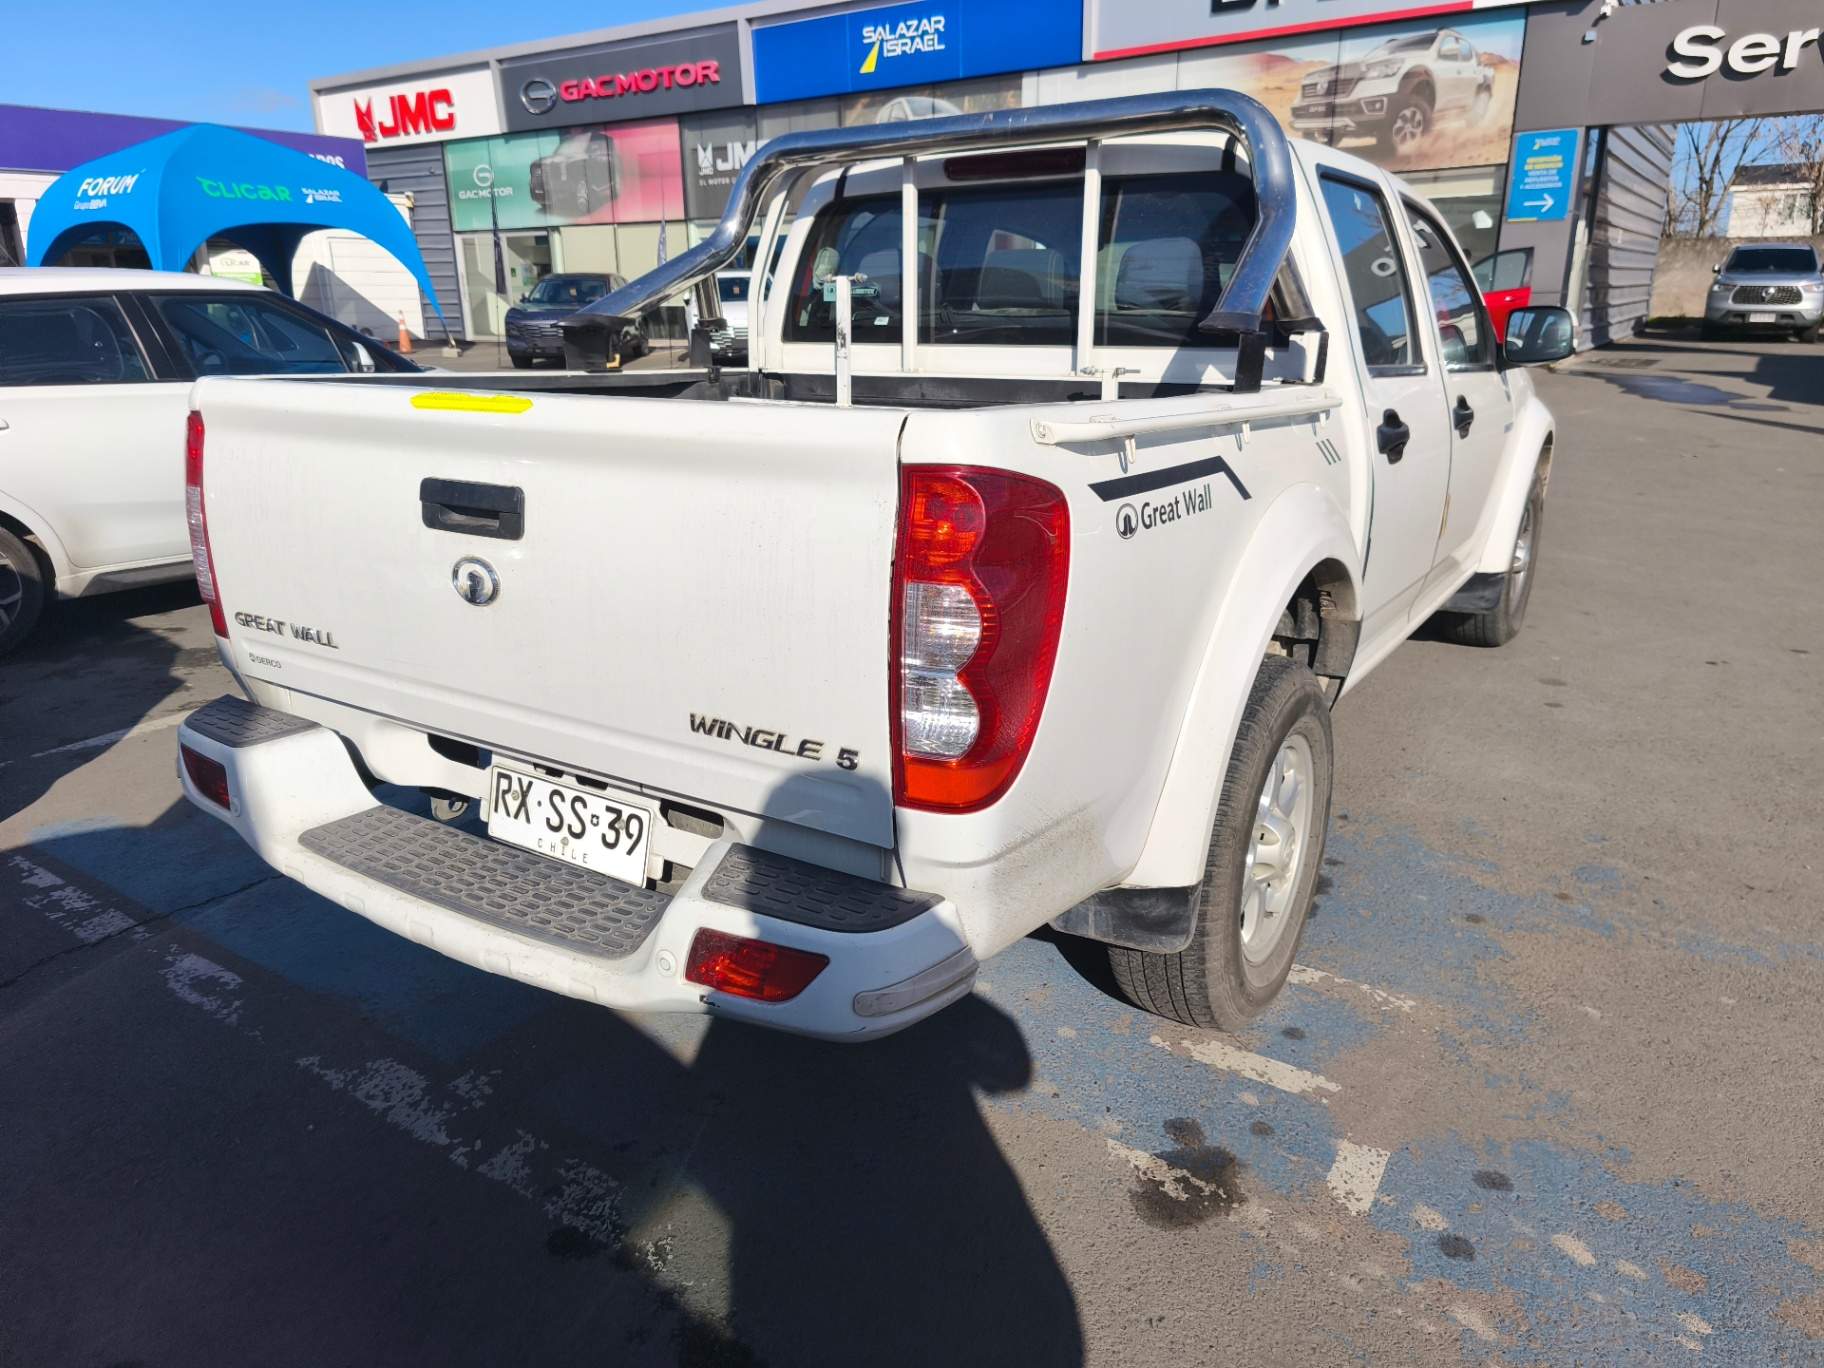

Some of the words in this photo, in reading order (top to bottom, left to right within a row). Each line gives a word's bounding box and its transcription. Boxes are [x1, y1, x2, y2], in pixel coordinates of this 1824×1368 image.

[863, 16, 945, 43] SALAZAR
[883, 34, 945, 57] ISRAEL
[379, 89, 456, 138] JMC
[716, 139, 771, 171] JM
[76, 173, 140, 198] FORUM
[1141, 496, 1181, 530] Great
[1183, 484, 1212, 516] Wall
[234, 611, 285, 637] GREAT
[290, 622, 339, 649] WALL
[690, 712, 824, 761] WINGLE
[835, 747, 859, 771] 5
[537, 837, 588, 864] CHILE
